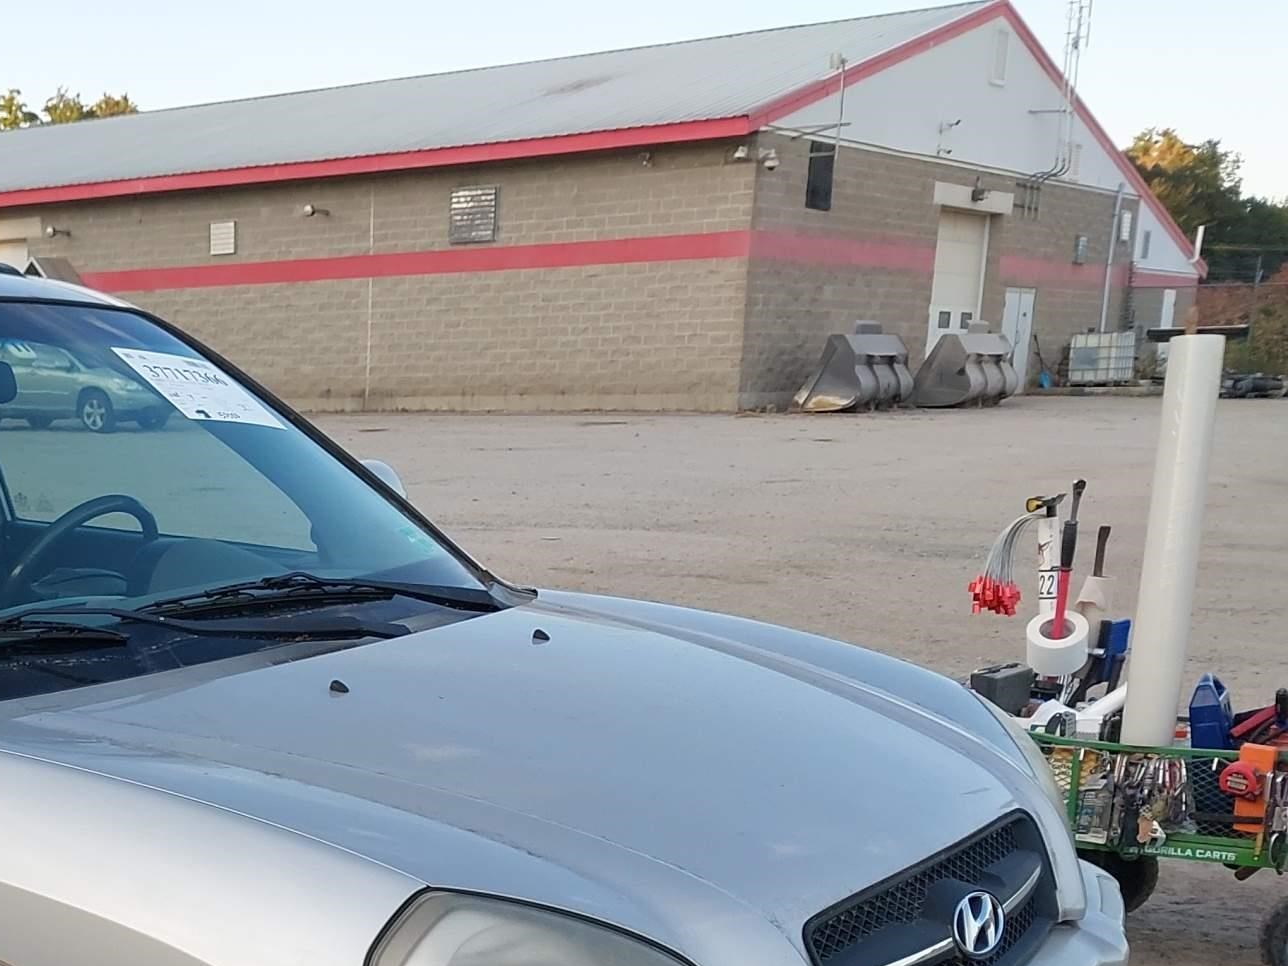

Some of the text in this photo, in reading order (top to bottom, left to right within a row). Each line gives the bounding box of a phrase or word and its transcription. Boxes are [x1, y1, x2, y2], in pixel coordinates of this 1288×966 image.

[143, 364, 229, 387] 37717366
[1039, 574, 1055, 595] 22
[1195, 848, 1238, 863] CARTS
